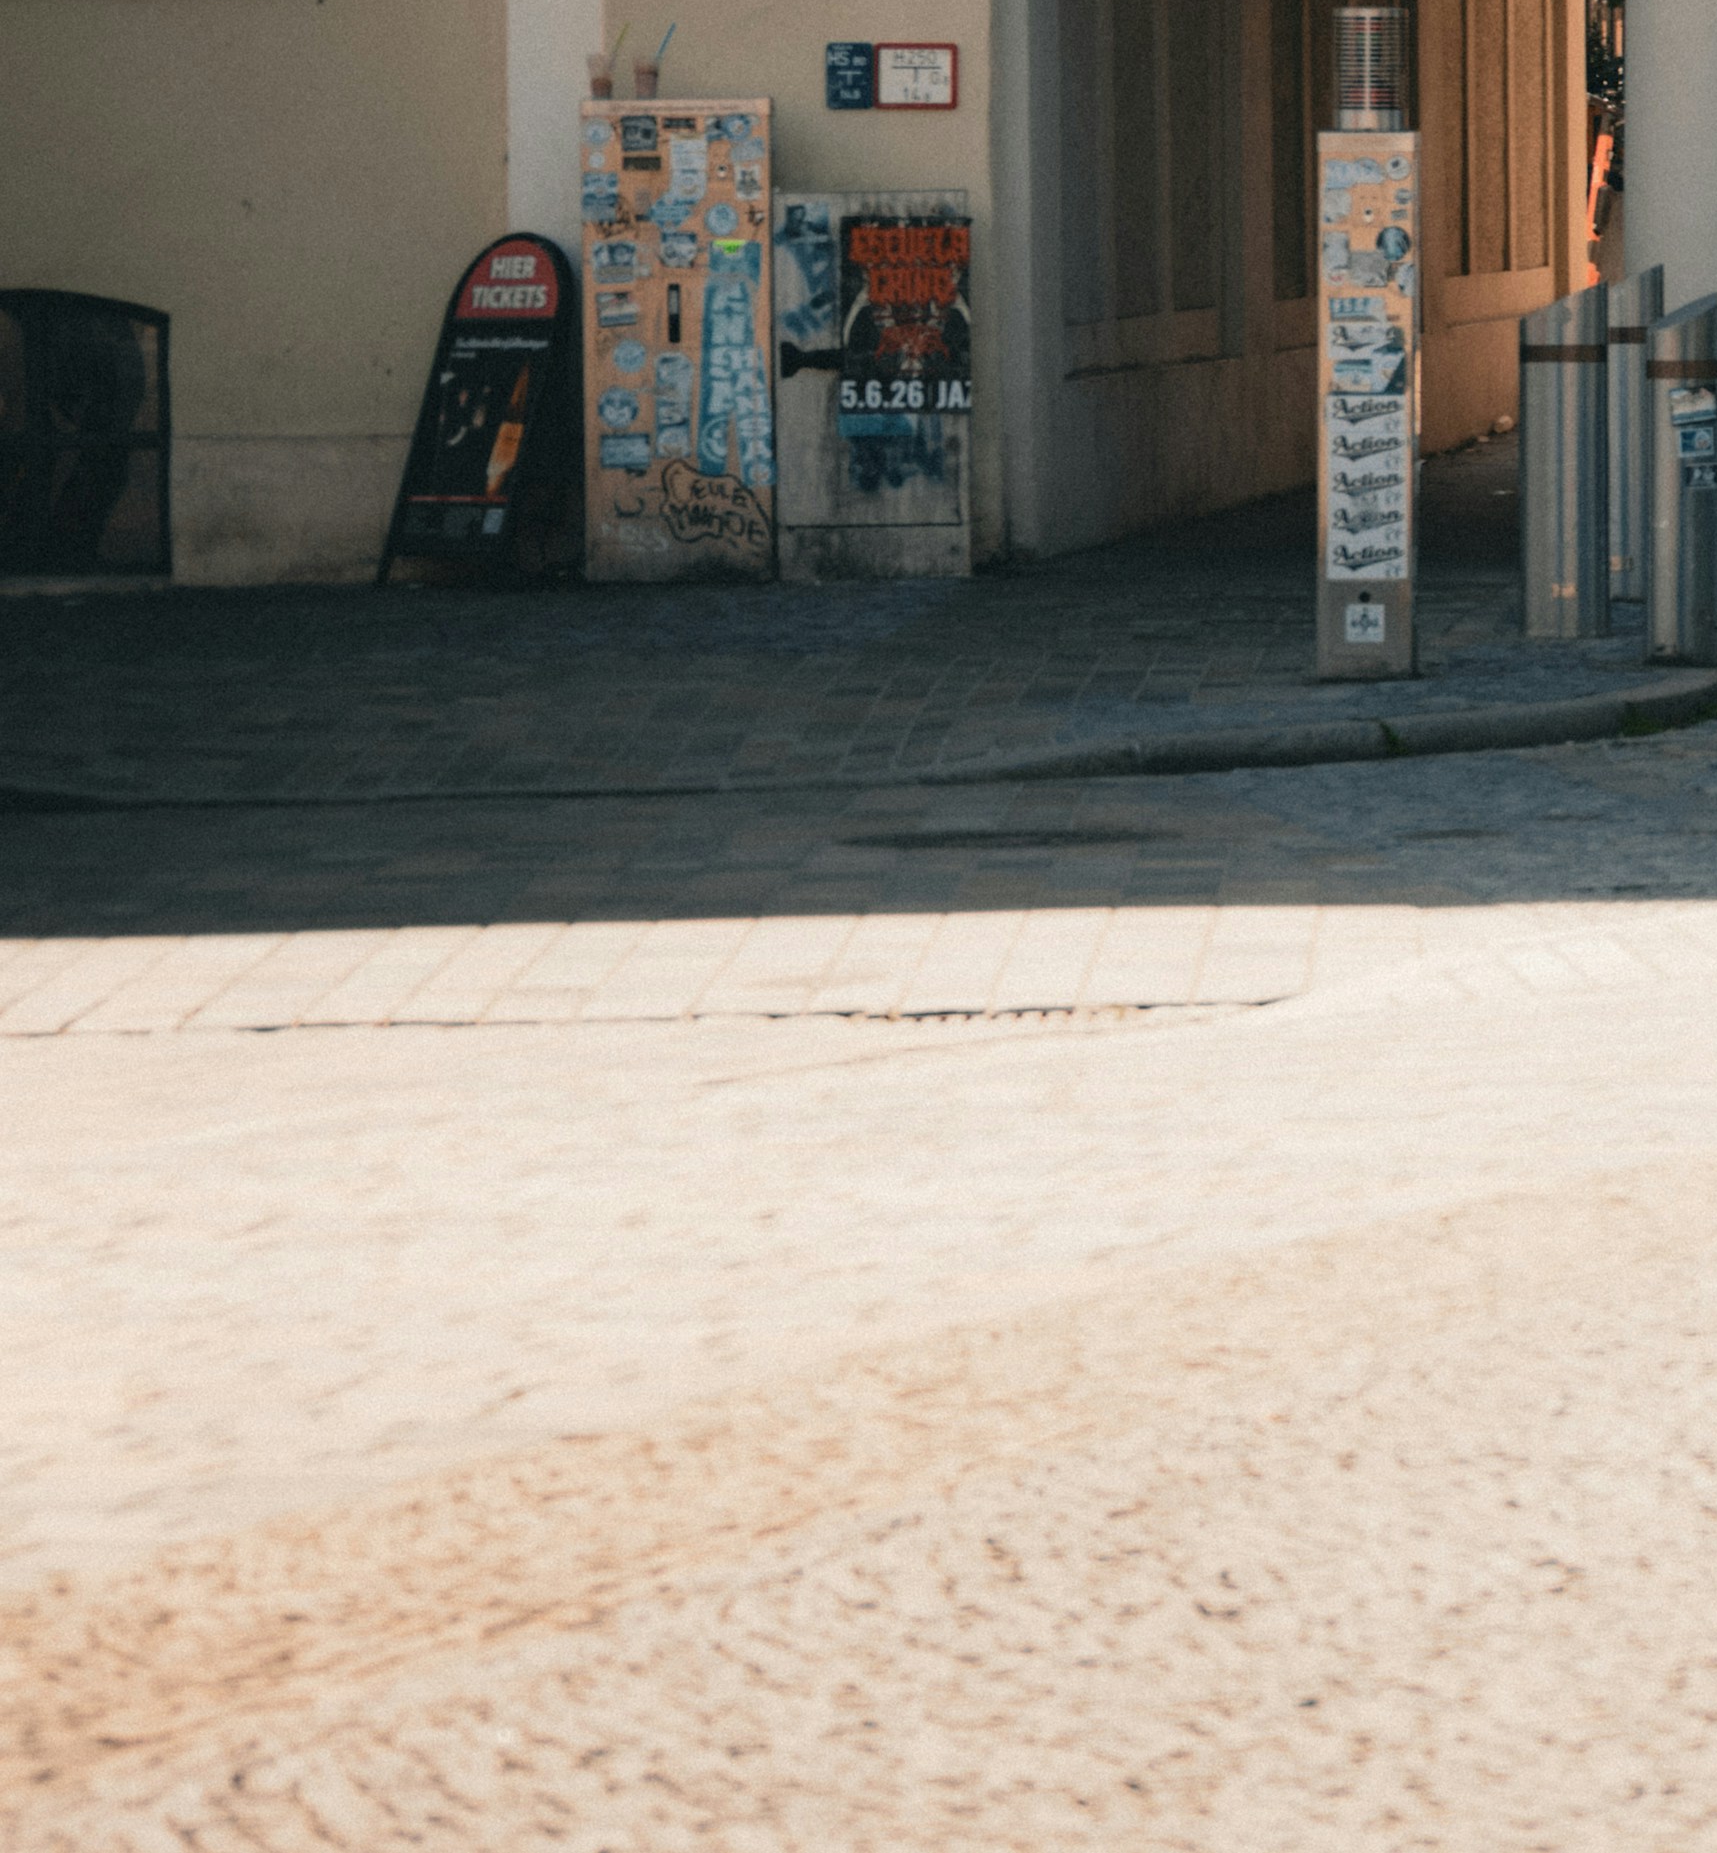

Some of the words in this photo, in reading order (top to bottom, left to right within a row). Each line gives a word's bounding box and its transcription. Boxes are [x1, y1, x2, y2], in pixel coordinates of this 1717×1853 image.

[489, 255, 538, 280] HIER
[471, 284, 549, 310] TICKETS
[840, 378, 925, 410] 5.6.26
[1332, 398, 1402, 418] Action
[1332, 435, 1402, 455] Action
[1332, 472, 1402, 492] Action
[1332, 544, 1402, 565] Action
